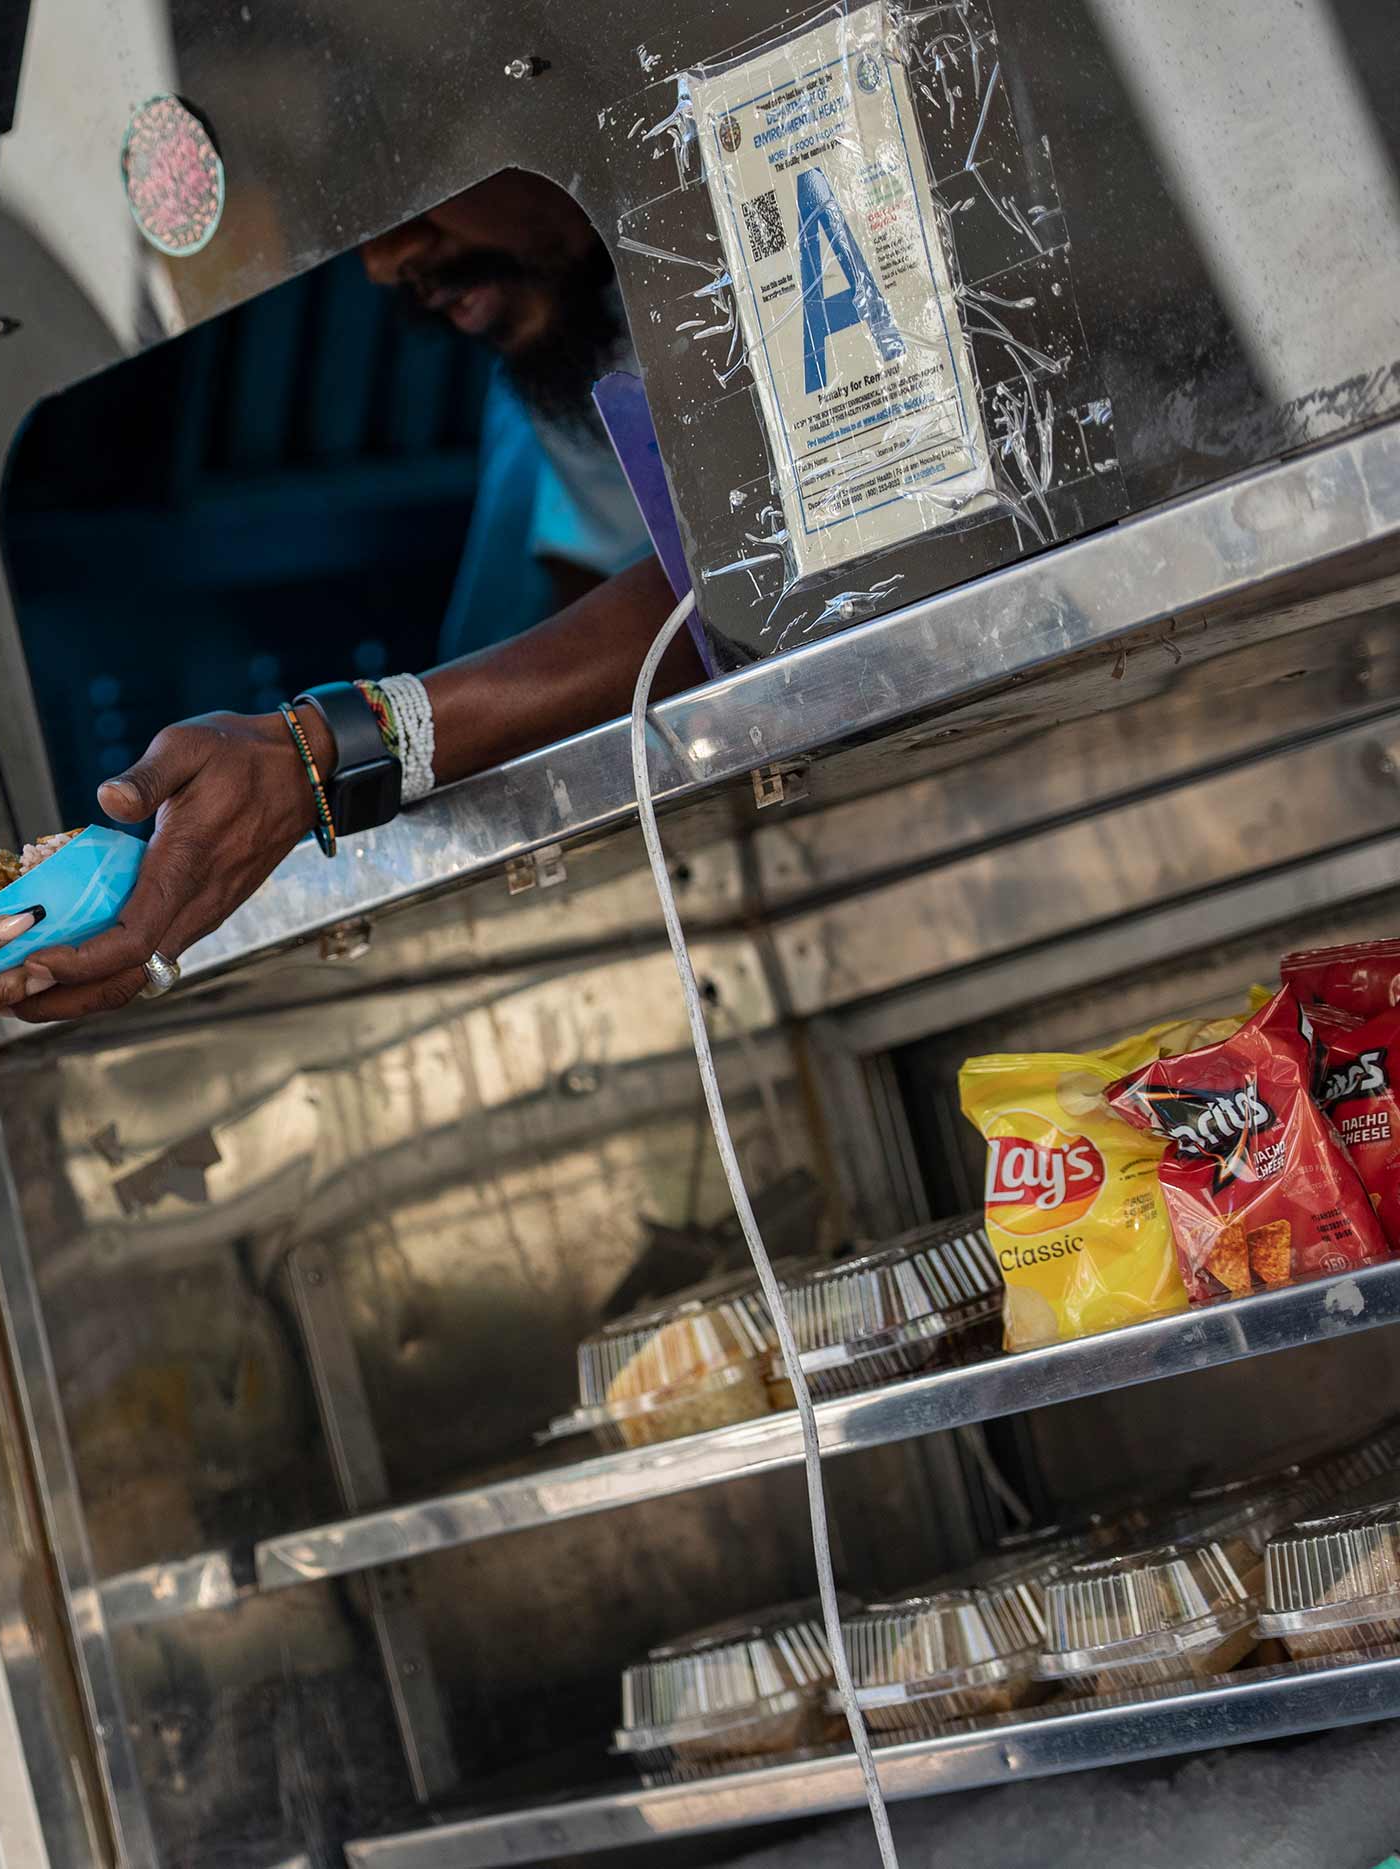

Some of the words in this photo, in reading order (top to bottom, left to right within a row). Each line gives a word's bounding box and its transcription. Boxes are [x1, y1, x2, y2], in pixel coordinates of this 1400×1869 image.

[817, 86, 827, 101] OF
[795, 137, 814, 151] FOOD
[797, 167, 905, 395] A
[850, 381, 861, 392] for
[864, 364, 899, 386] Remval
[877, 472, 892, 482] Health
[984, 1140, 1094, 1210] Lay's
[1255, 1155, 1286, 1180] CHEESE
[999, 1234, 1085, 1272] Classic
